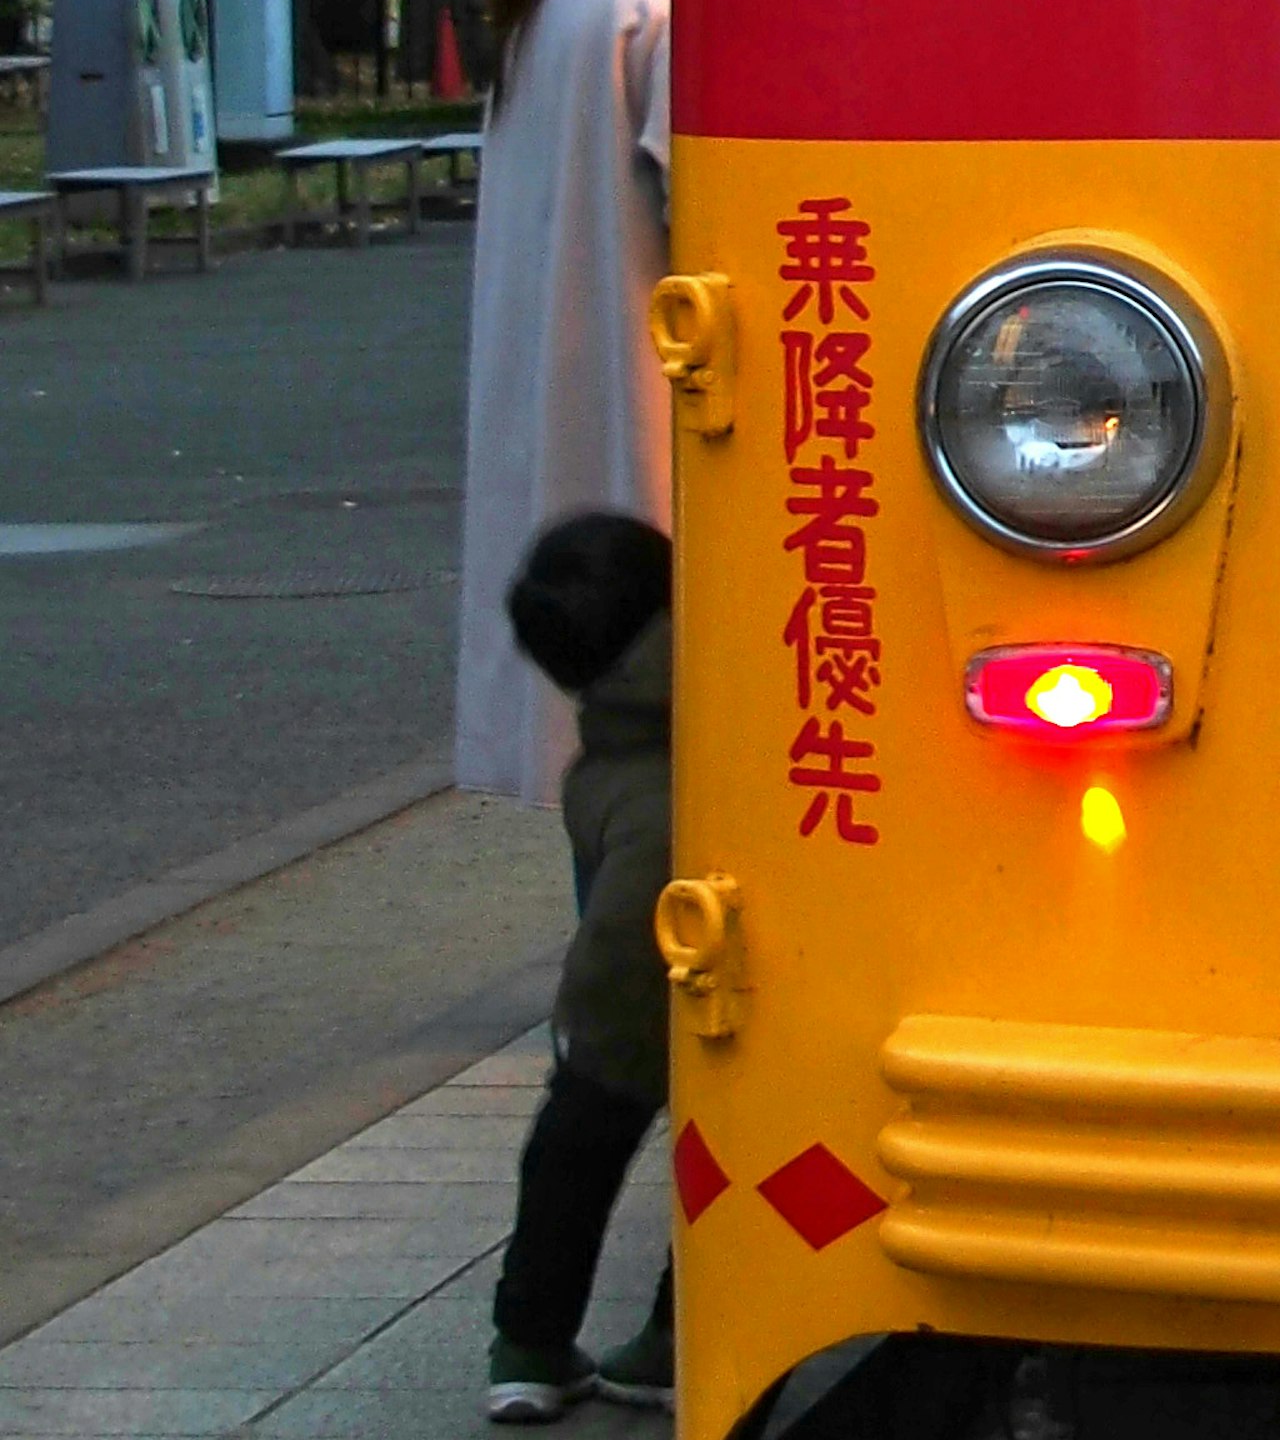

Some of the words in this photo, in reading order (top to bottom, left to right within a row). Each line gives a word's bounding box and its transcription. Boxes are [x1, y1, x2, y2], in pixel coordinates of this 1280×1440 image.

[777, 198, 881, 845] 乗降者優先
